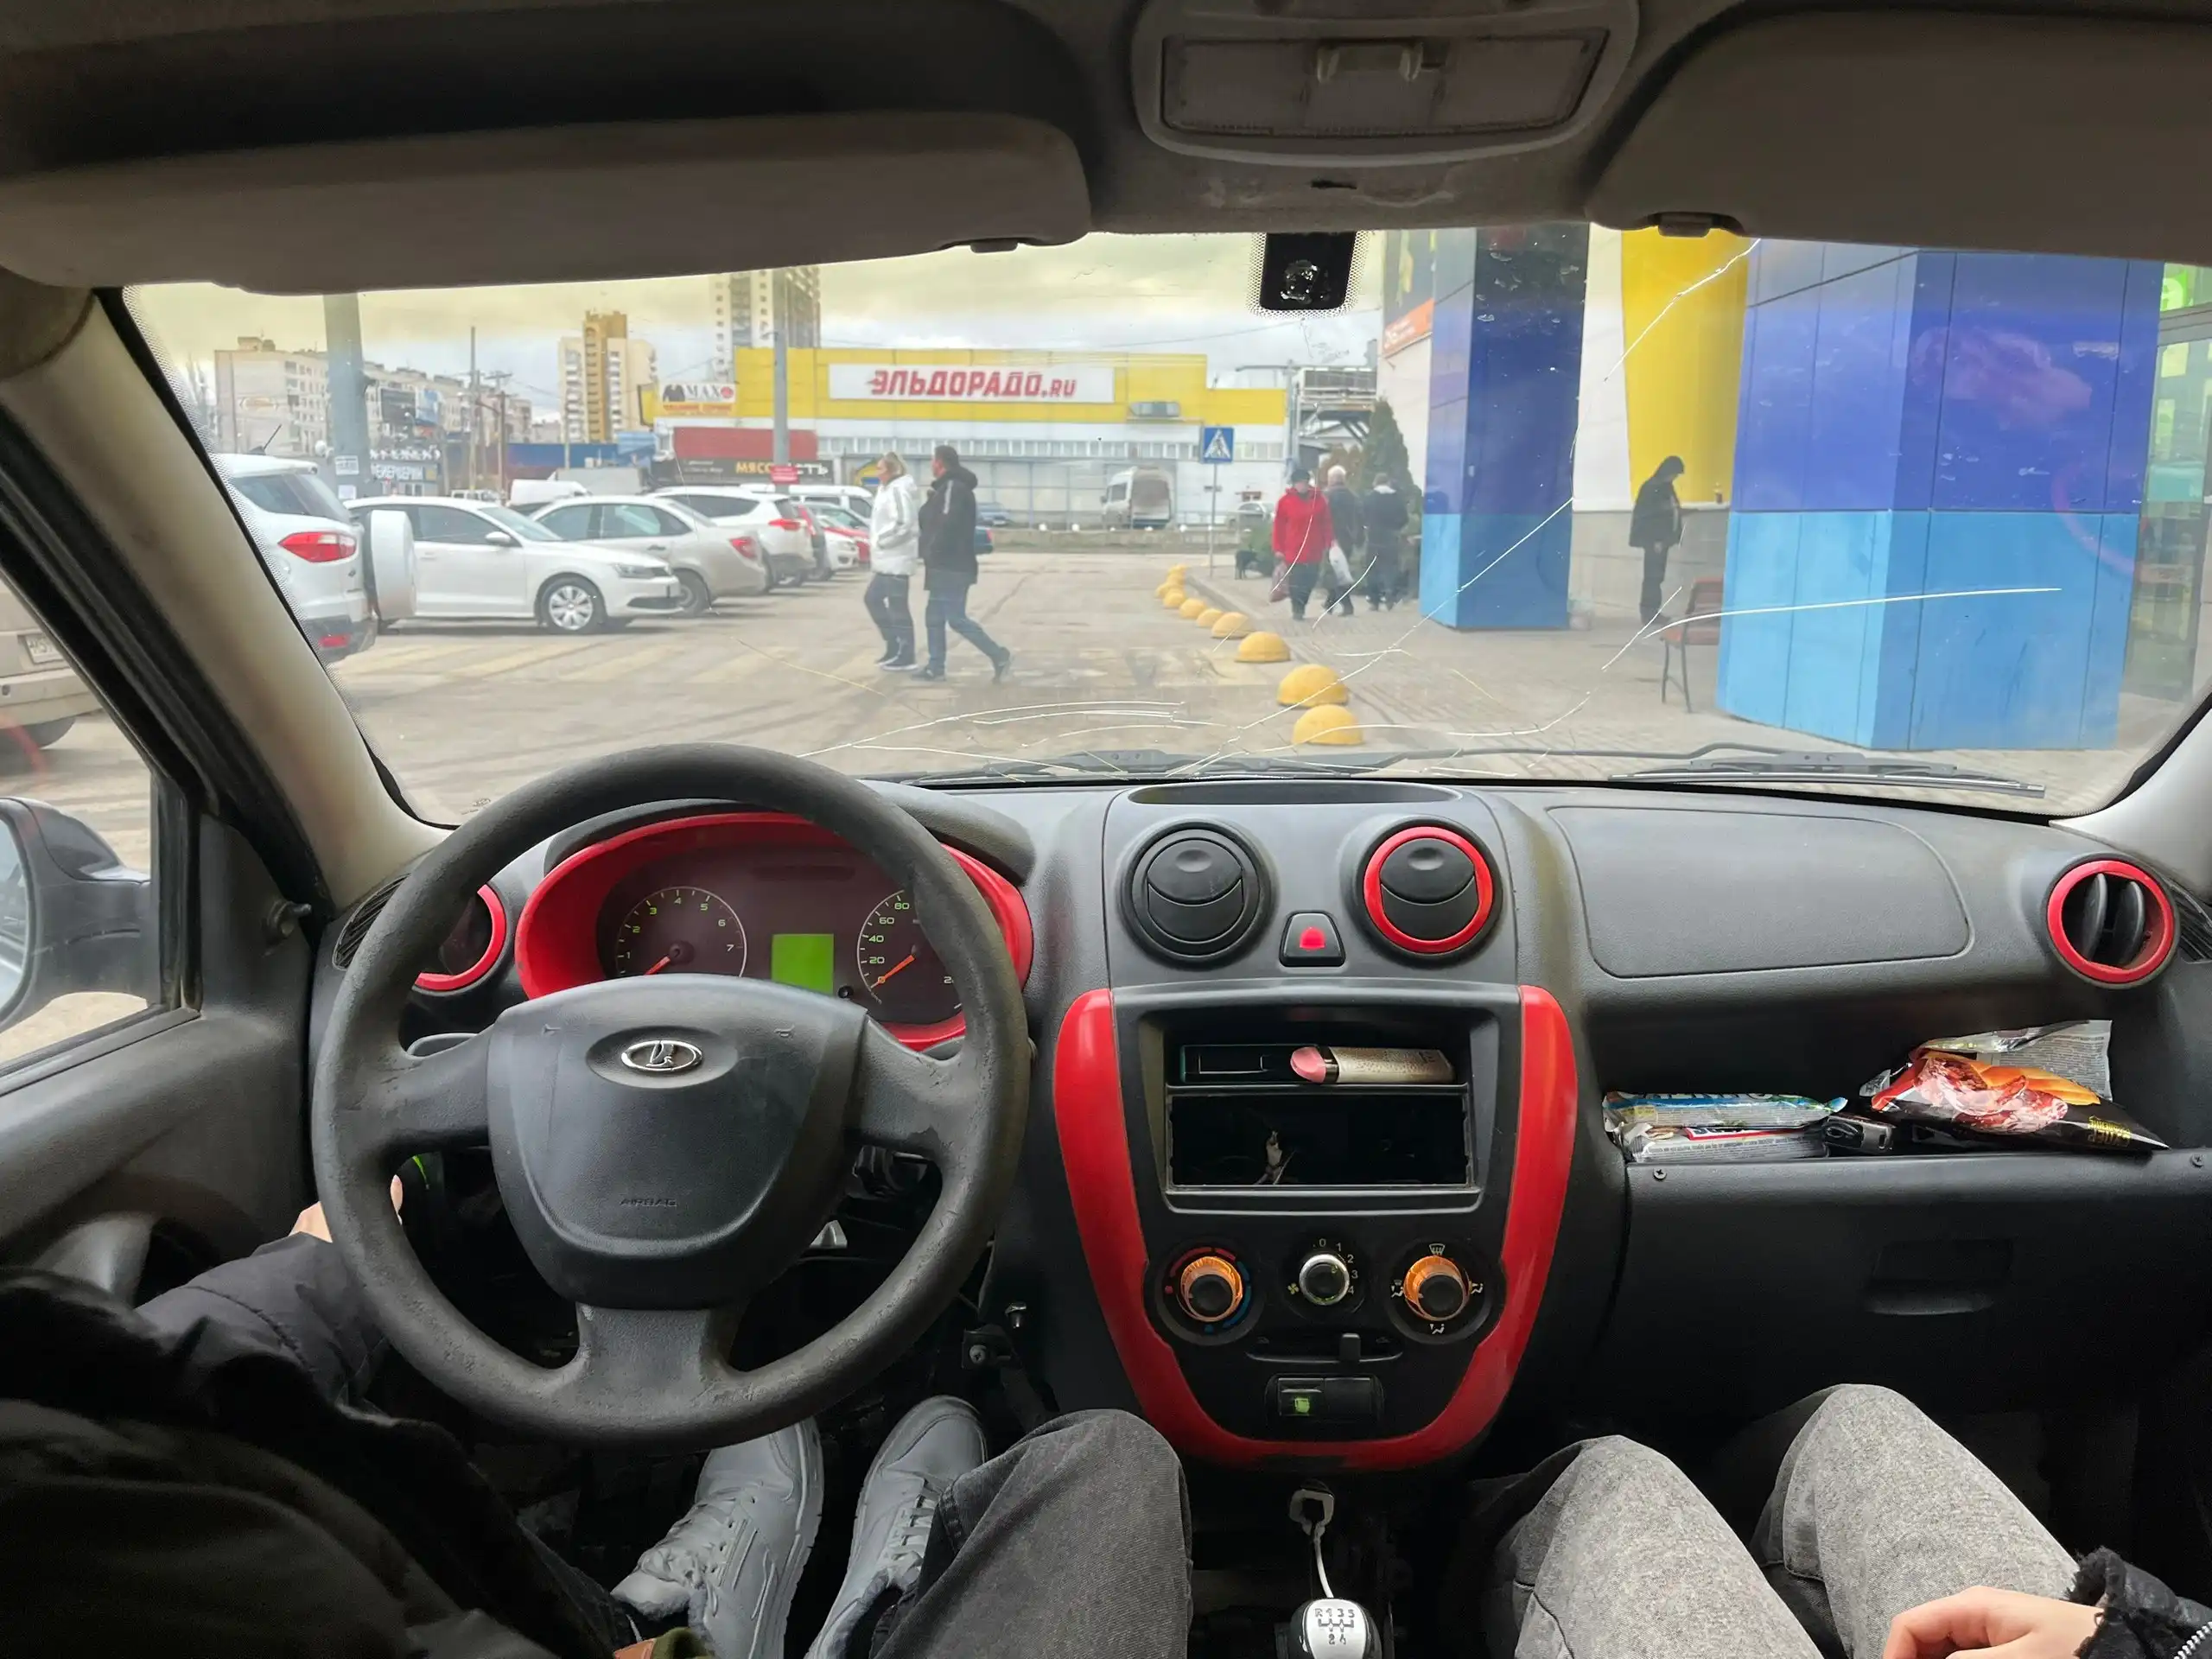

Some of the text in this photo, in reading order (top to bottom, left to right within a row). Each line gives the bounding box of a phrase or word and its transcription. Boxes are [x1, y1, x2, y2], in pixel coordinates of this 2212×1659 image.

[868, 370, 1077, 397] ЭЛЬДОРАДО.RU
[1336, 1242, 1342, 1251] 1
[1347, 1254, 1354, 1263] 2
[1351, 1269, 1358, 1279] 3
[1348, 1285, 1355, 1294] 4
[1314, 1608, 1355, 1618] R 1 3 5
[1328, 1633, 1335, 1644] 2
